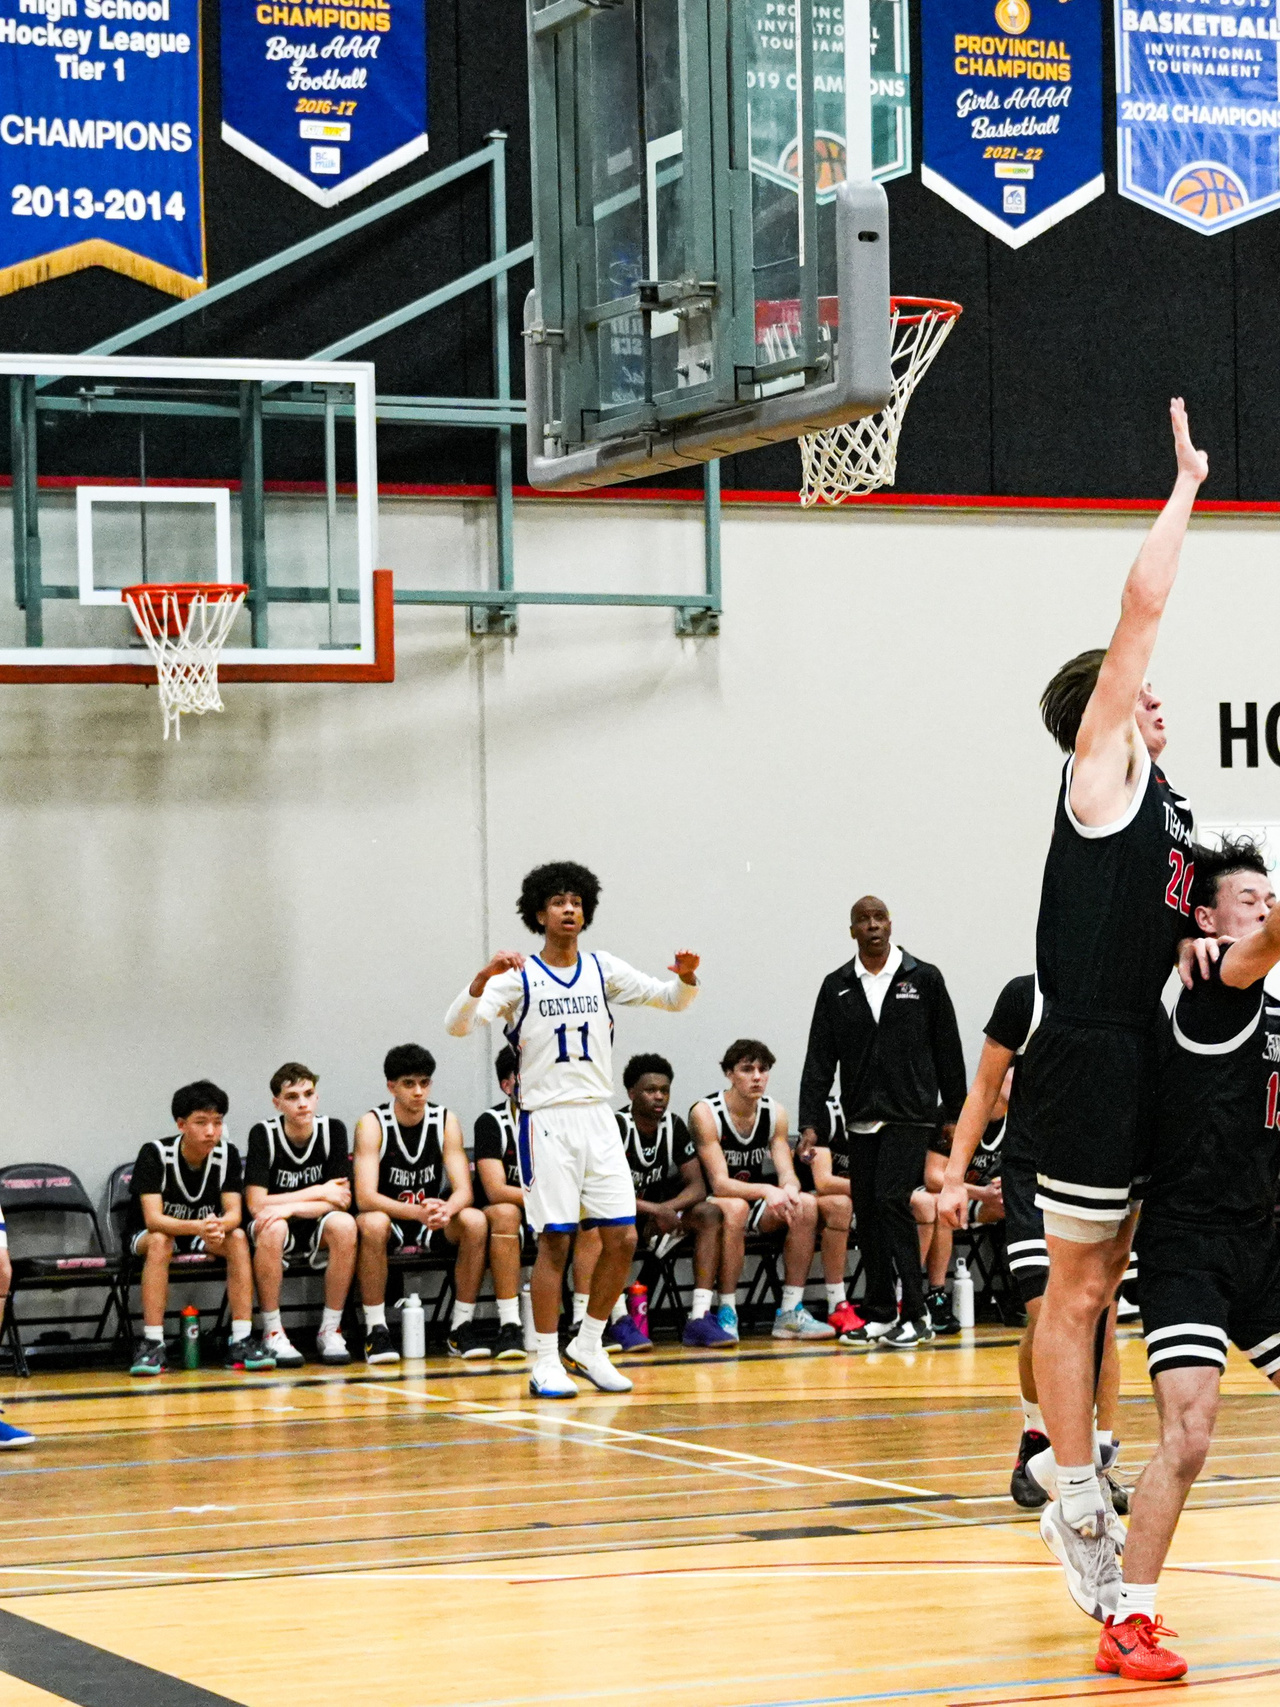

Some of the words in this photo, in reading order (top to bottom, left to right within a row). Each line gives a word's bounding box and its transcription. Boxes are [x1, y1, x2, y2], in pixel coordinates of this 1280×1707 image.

[85, 0, 170, 21] School
[256, 4, 391, 32] CHAMPIONS
[0, 18, 92, 55] Hockey
[99, 25, 191, 58] League
[954, 34, 1071, 61] PROVINCIAL
[266, 36, 318, 67] Boys
[321, 35, 381, 59] AAA
[1145, 43, 1263, 61] INVITATIONAL
[55, 54, 105, 80] Tier
[113, 58, 125, 82] 1
[286, 67, 367, 90] Football
[955, 56, 1071, 82] CHAMPIONS
[1148, 60, 1260, 78] TOURNAMENT
[295, 98, 357, 115] 2016-17
[956, 88, 1000, 118] Girls
[1003, 86, 1072, 109] AAAA
[1121, 101, 1169, 122] 2024
[0, 114, 192, 152] CHAMPIONS
[971, 114, 1060, 139] Basketball
[983, 146, 1043, 161] 2021-22
[11, 184, 186, 221] 2013-2014
[538, 995, 600, 1017] CENTAURS
[554, 1021, 593, 1063] 11
[304, 1164, 323, 1183] FOX
[388, 1166, 416, 1187] TERRY
[419, 1163, 436, 1185] FOX
